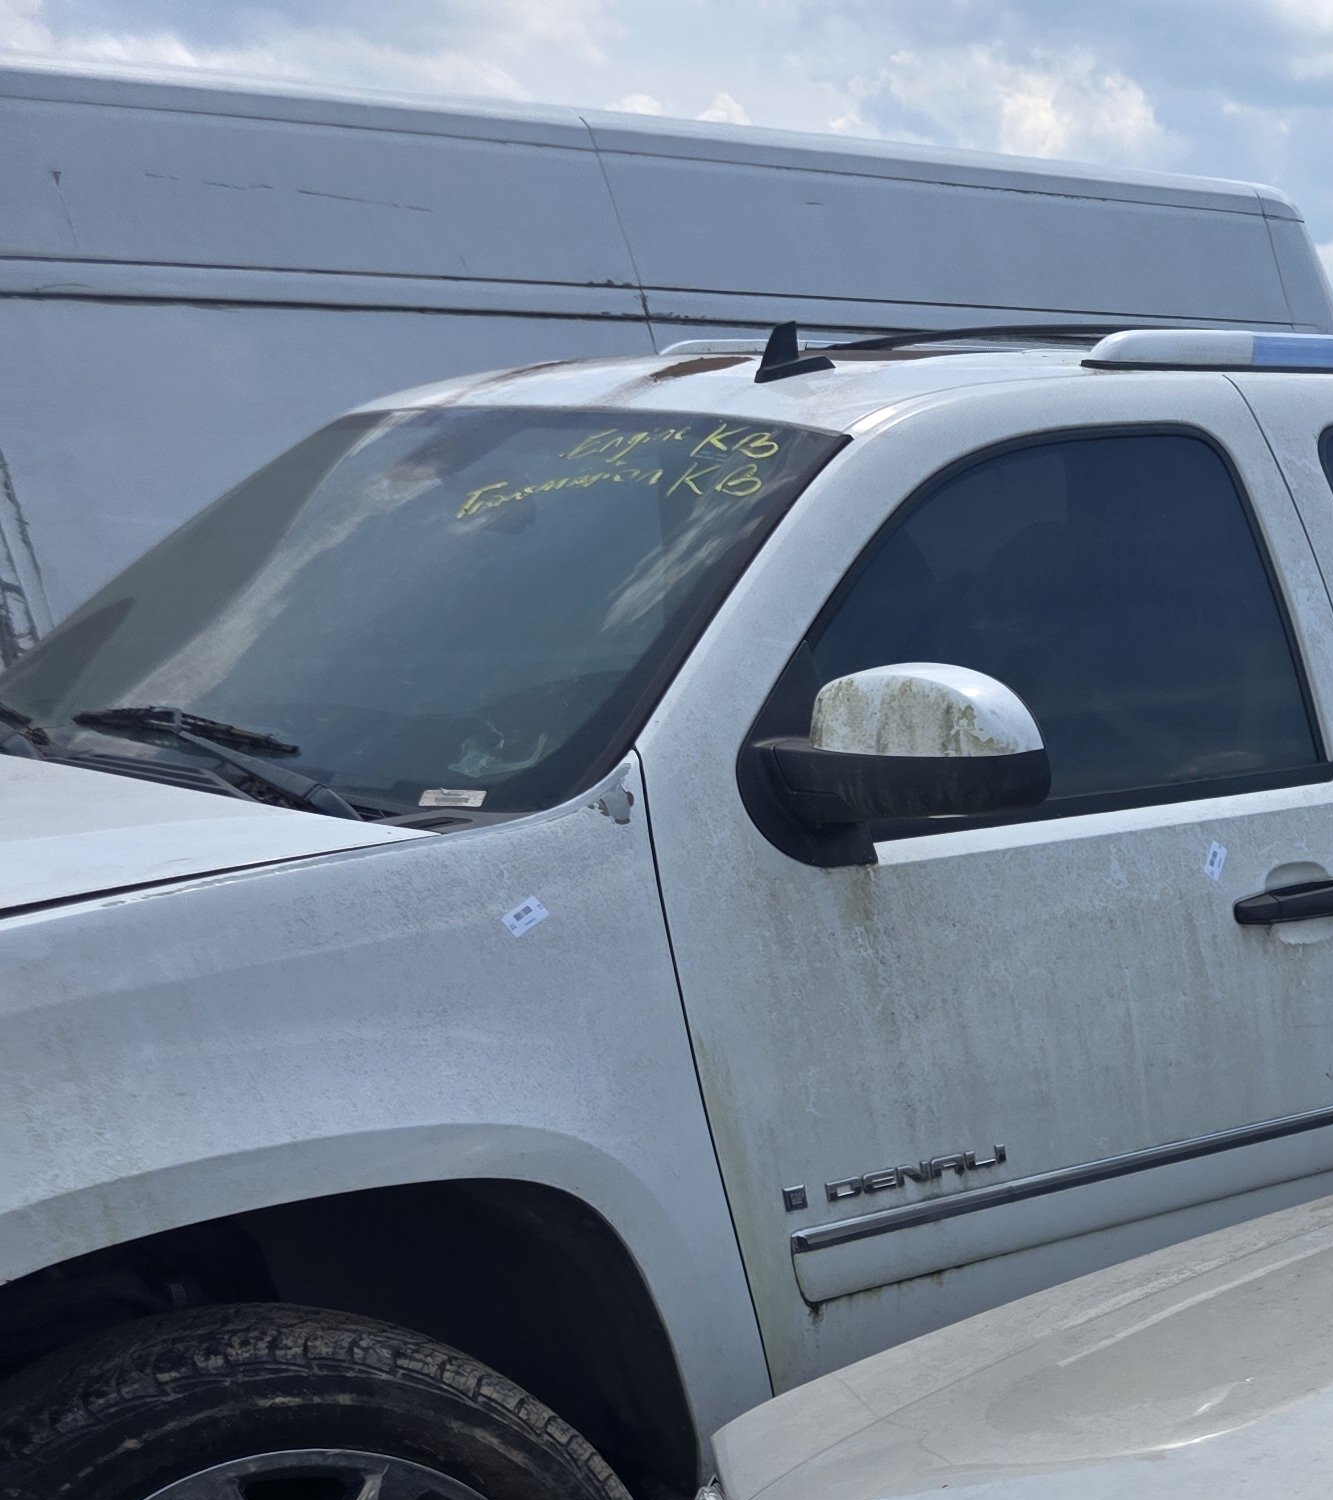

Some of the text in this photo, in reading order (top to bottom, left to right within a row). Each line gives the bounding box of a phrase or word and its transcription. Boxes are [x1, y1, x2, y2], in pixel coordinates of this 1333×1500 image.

[689, 422, 779, 459] KB
[666, 461, 762, 497] KB
[824, 1143, 1008, 1203] DENALI
